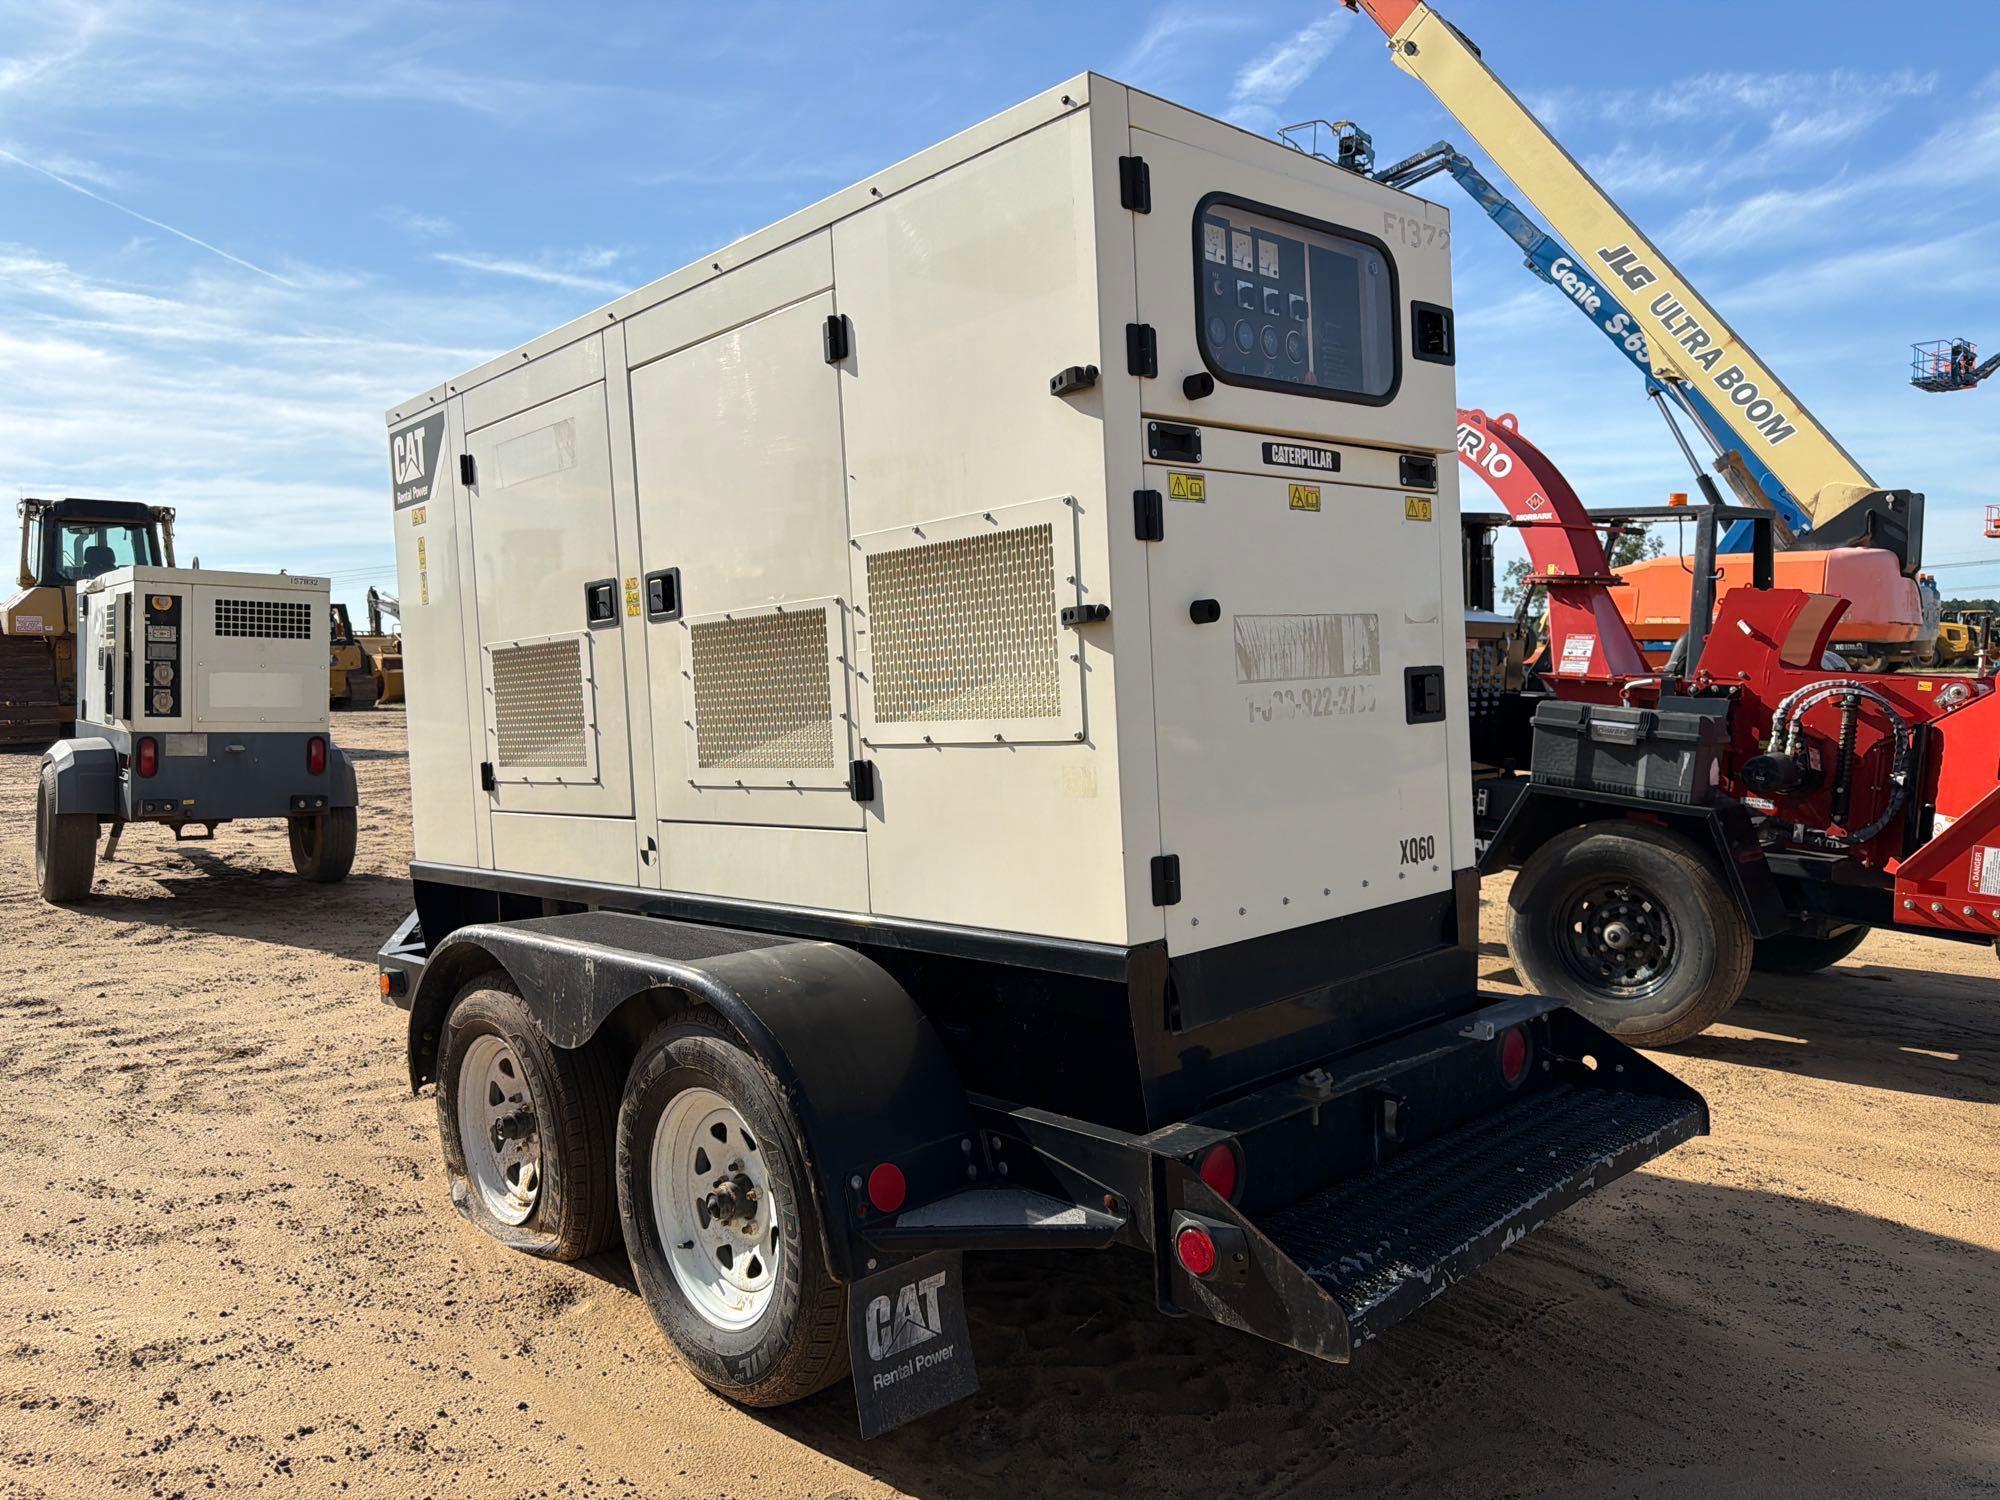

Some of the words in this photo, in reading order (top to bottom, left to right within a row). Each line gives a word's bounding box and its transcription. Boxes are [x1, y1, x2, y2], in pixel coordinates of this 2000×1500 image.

[1550, 257, 1601, 316] Genie
[1597, 243, 1659, 293] JLG
[1650, 291, 1725, 373] ULTRA
[1712, 364, 1798, 446] BOOM
[393, 426, 426, 485] CAT
[1271, 444, 1333, 469] CATERPILLAR
[1480, 442, 1513, 478] 10
[397, 488, 412, 504] Rental
[412, 485, 429, 499] Power
[1515, 513, 1553, 521] MORBARK
[1399, 835, 1435, 865] XQ60
[1972, 851, 1983, 881] DANGER
[865, 1269, 947, 1361] CAT
[872, 1359, 914, 1391] Rental
[915, 1344, 954, 1373] Power
